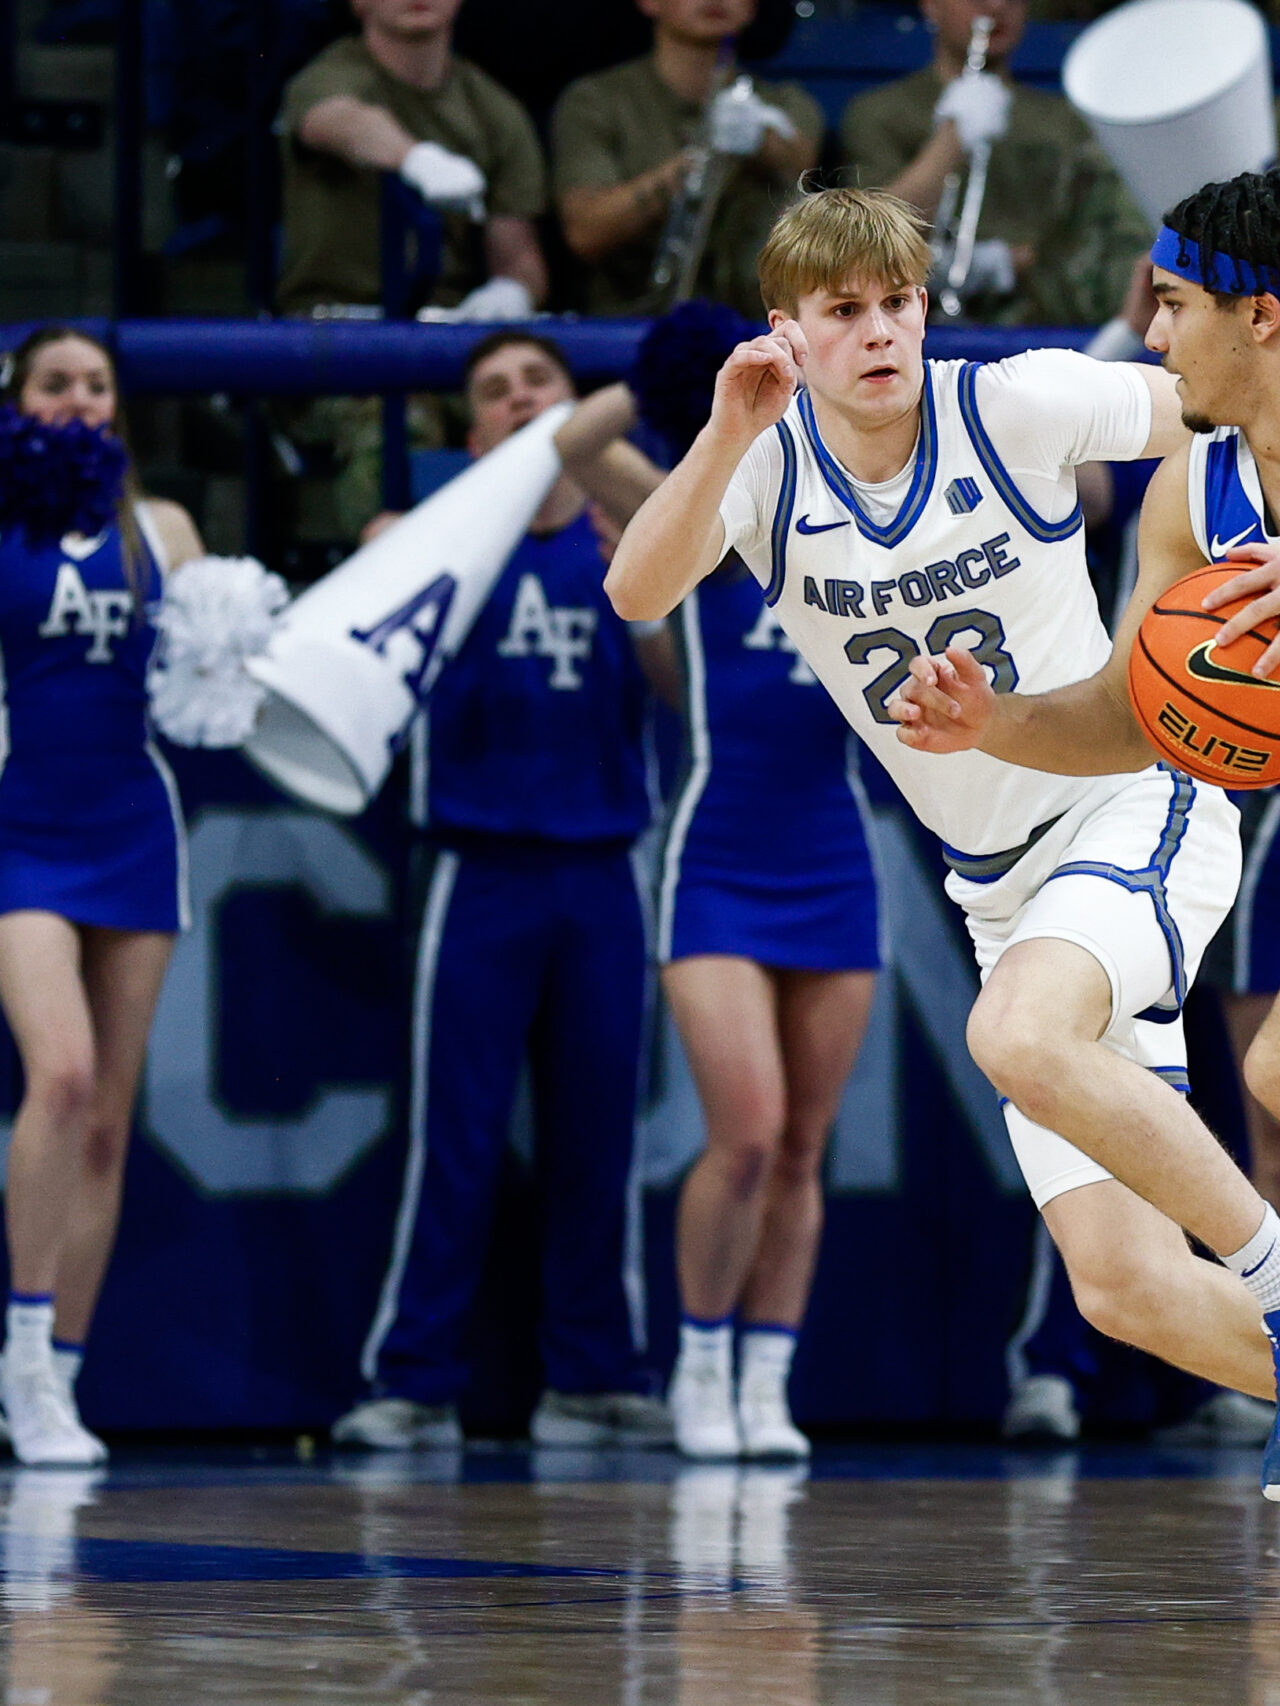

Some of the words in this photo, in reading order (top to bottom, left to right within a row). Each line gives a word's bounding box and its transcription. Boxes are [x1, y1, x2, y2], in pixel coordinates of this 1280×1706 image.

[38, 562, 134, 664] AF
[803, 576, 866, 618] AIR
[871, 532, 1021, 616] FORCE
[497, 572, 597, 690] AF
[843, 608, 1020, 724] 23
[1158, 700, 1271, 772] ELITE
